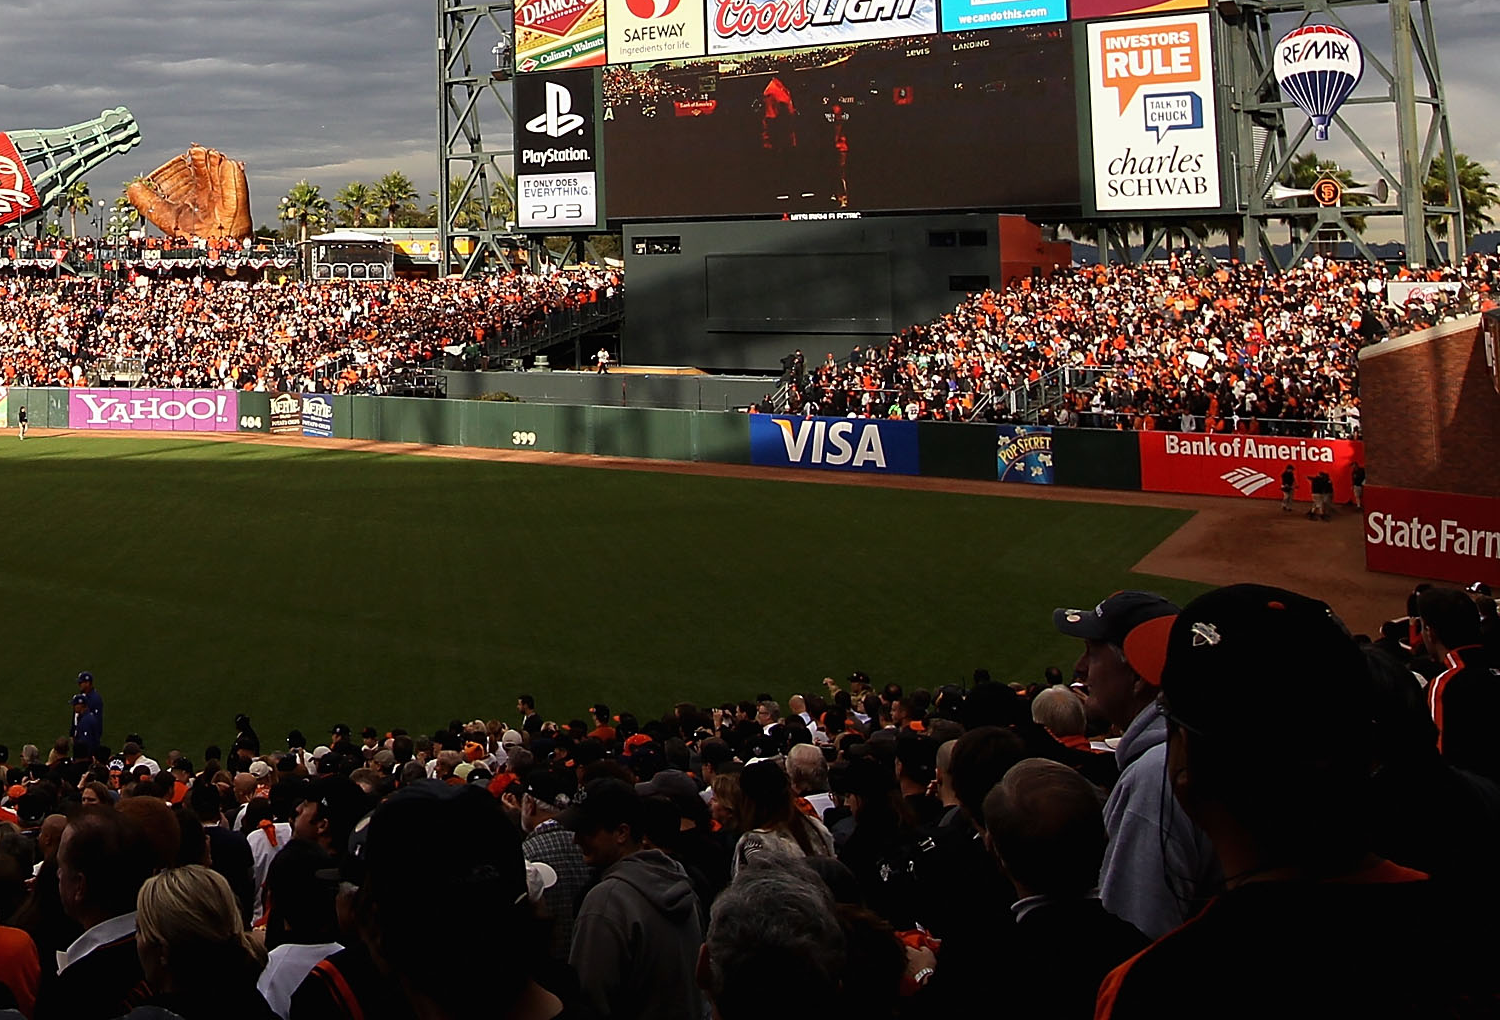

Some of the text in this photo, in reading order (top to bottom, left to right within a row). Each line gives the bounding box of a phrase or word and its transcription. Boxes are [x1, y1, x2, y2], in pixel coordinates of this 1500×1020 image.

[546, 5, 584, 22] CALIFORNIA
[958, 7, 1047, 24] wecandothis.com
[624, 23, 686, 43] SAFEWAY
[1105, 31, 1190, 50] INVESTORS
[540, 37, 605, 64] Culinary Walnuts
[619, 43, 663, 56] Ingredients
[664, 41, 676, 51] for
[1282, 39, 1351, 66] RE/MAX
[1106, 46, 1192, 79] RULE
[1150, 99, 1188, 110] TALK TO
[1150, 110, 1188, 122] CHUCK
[1107, 145, 1204, 176] charles
[524, 178, 578, 188] IT ONLY DOES
[1107, 176, 1208, 198] SCHWAB
[532, 203, 582, 220] PS3
[76, 393, 228, 424] YAHOO!
[240, 415, 262, 429] 404
[512, 431, 537, 446] 399
[772, 418, 887, 468] VISA
[1165, 434, 1334, 463] Bank of America
[1367, 511, 1437, 551] State
